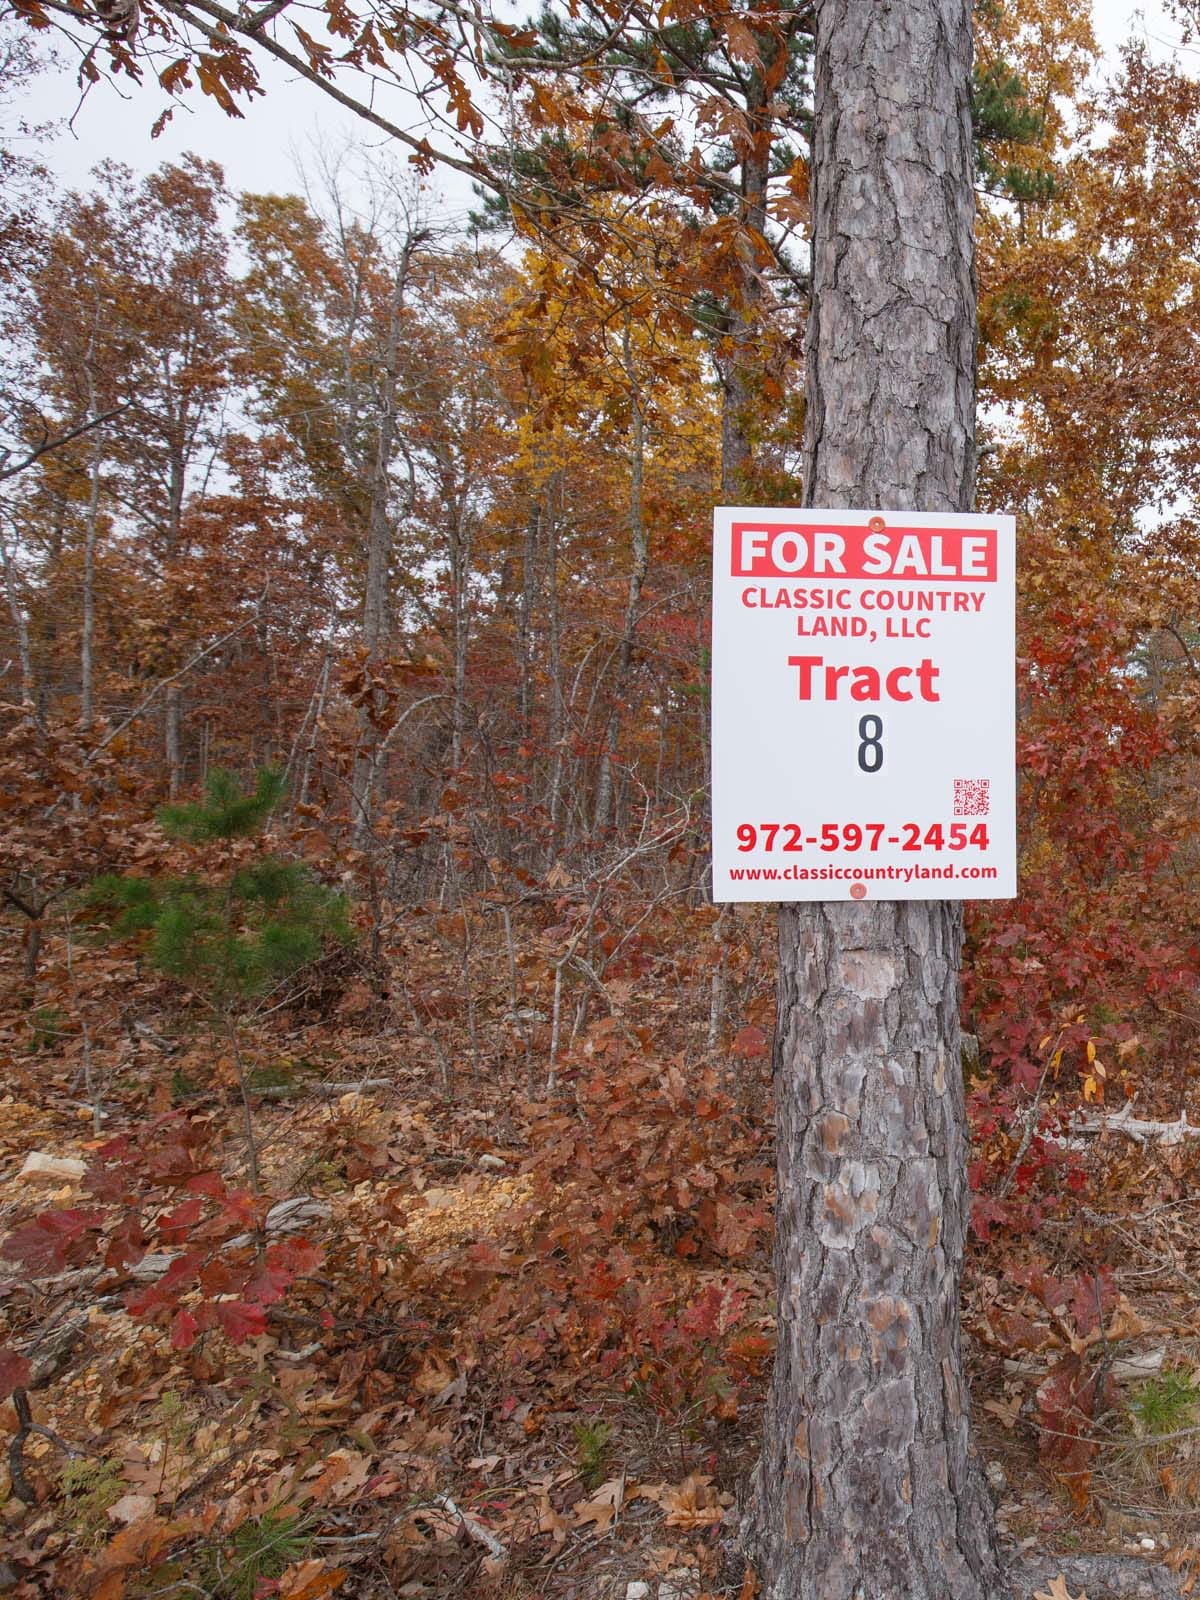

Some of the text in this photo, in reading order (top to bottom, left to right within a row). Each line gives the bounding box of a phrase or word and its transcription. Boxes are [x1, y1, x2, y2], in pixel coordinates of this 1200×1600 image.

[740, 531, 988, 577] FOR SALE
[741, 587, 986, 612] CLASSIC COUNTRY
[797, 616, 931, 642] LAND, LLC
[788, 655, 940, 702] Tract
[857, 714, 884, 773] 8
[736, 823, 989, 852] 972-597-2454
[729, 863, 998, 882] www.classiccountryland.com
